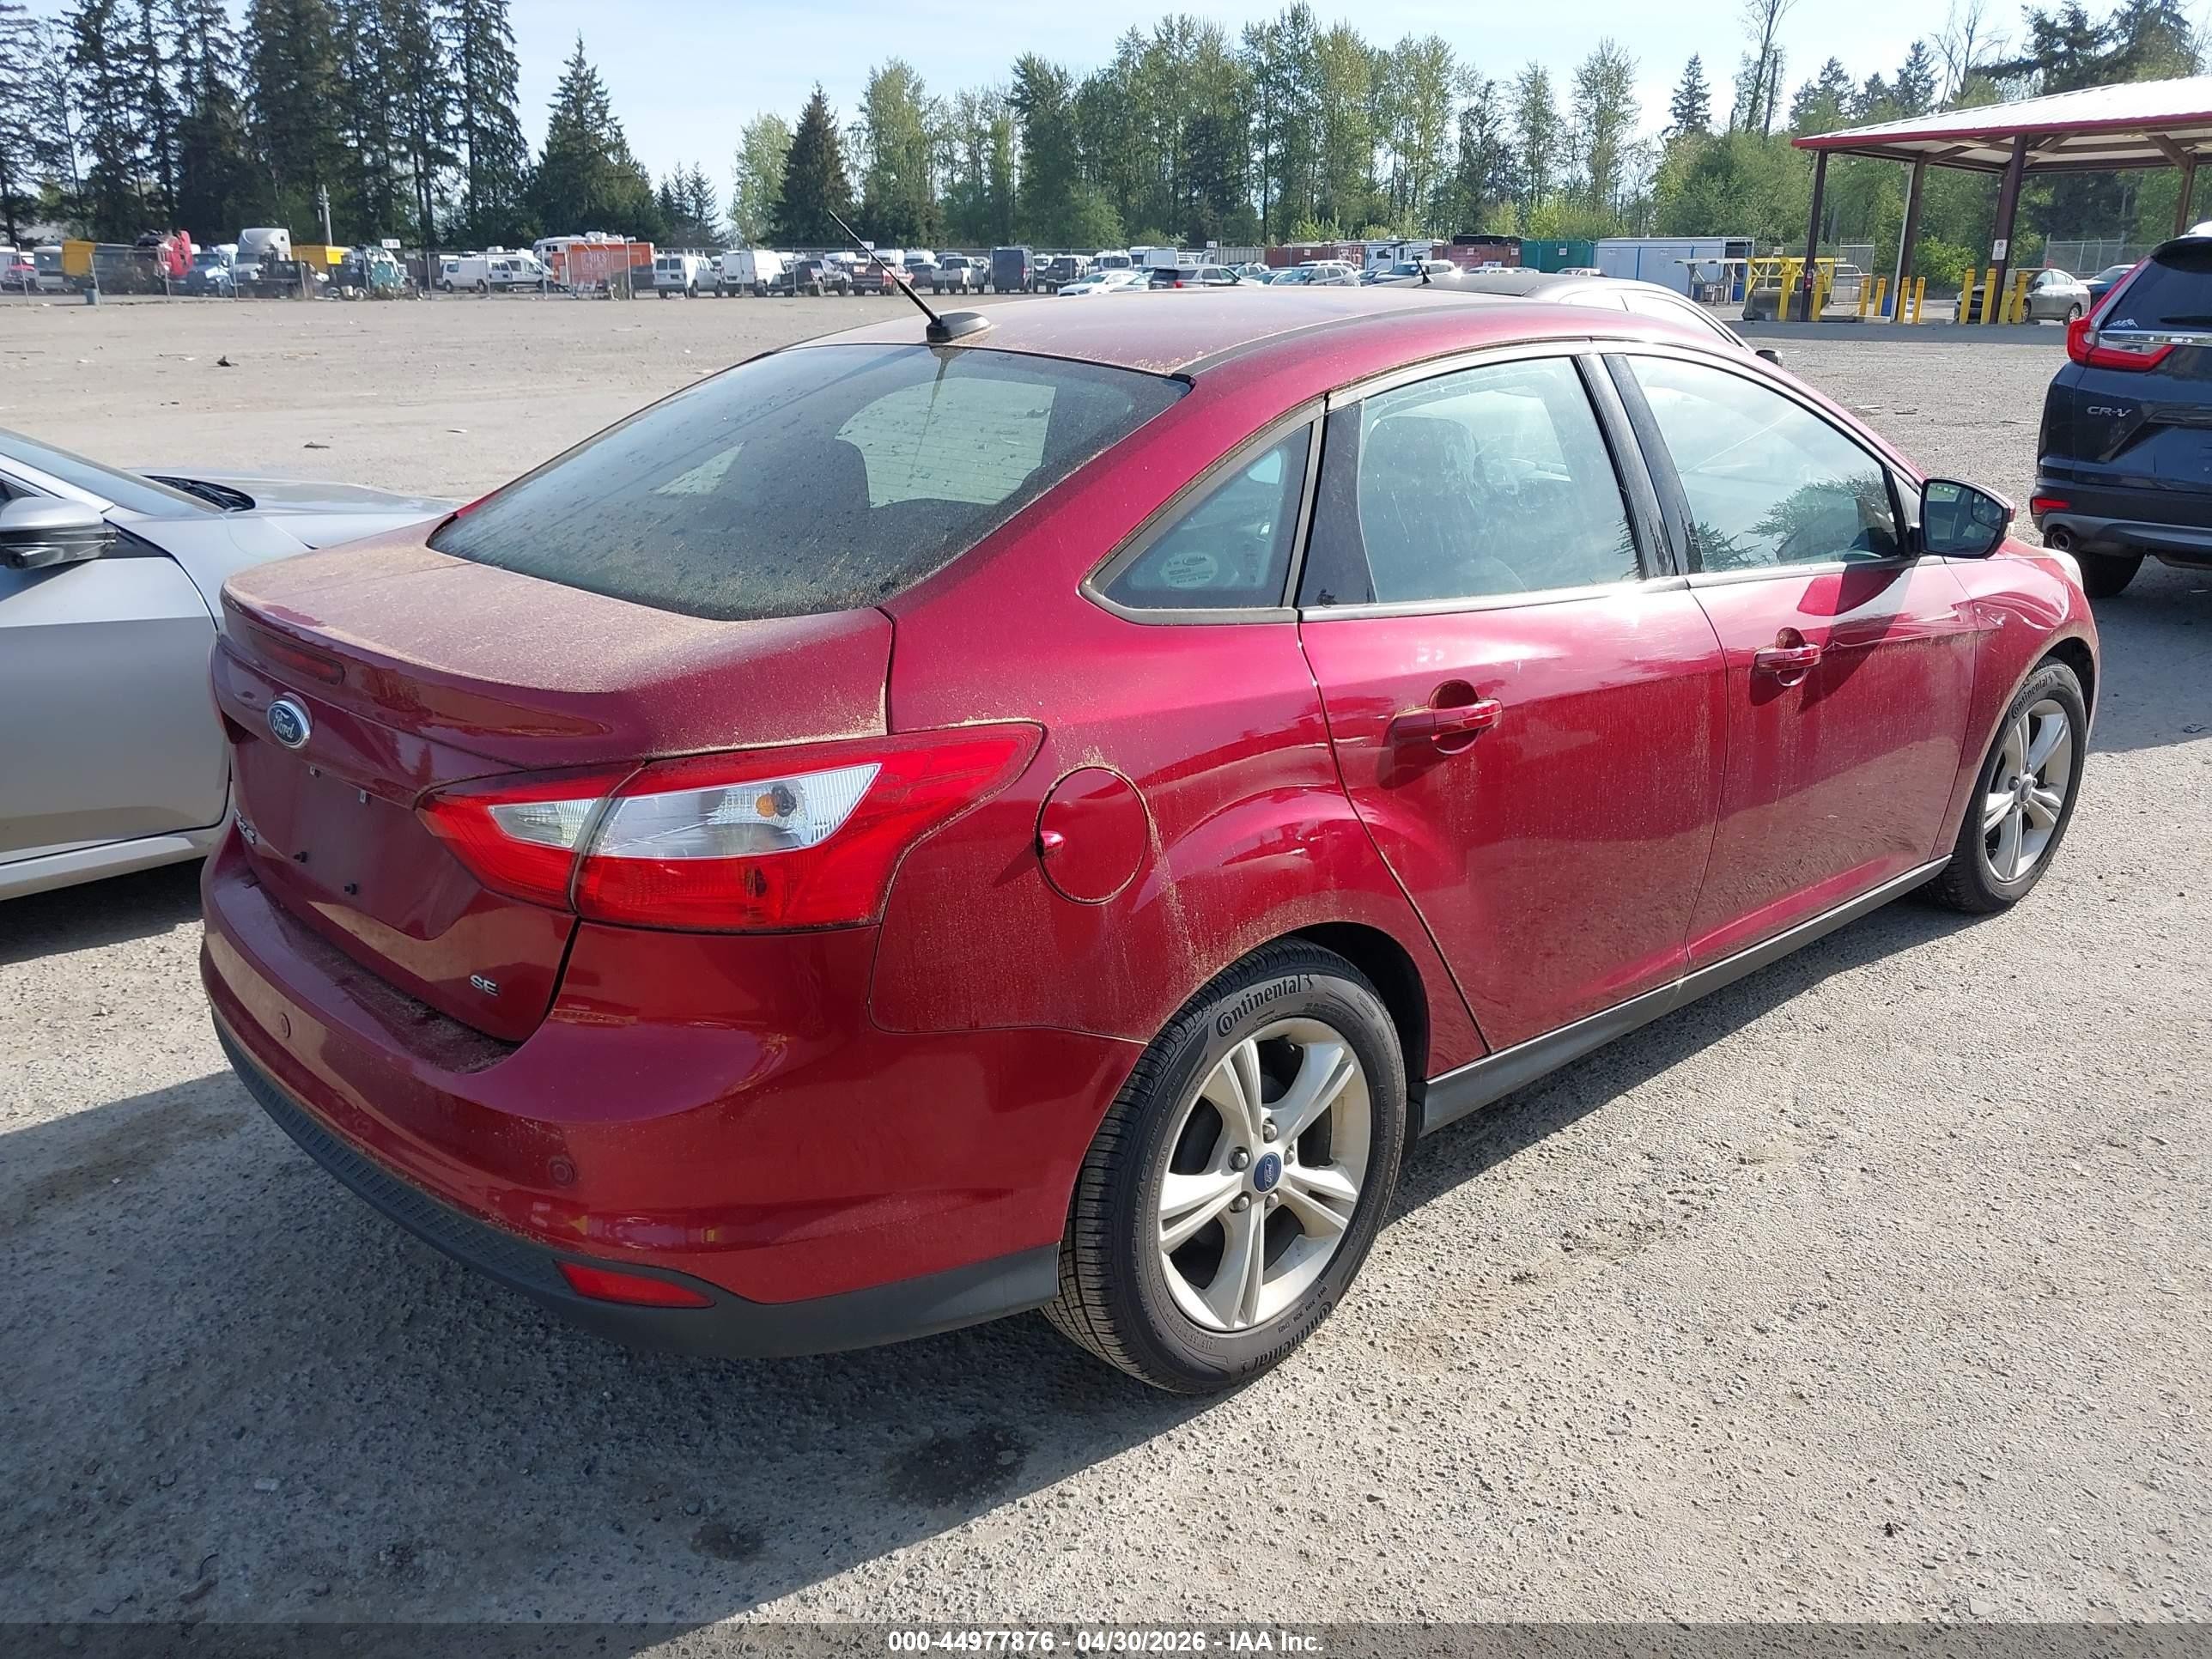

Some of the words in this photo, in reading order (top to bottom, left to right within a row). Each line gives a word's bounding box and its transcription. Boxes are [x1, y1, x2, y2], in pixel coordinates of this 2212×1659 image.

[2087, 405, 2133, 417] CR-V
[2011, 673, 2049, 720] Continental
[273, 708, 295, 738] Ford
[470, 975, 498, 996] SE
[1215, 974, 1302, 1038] Continental
